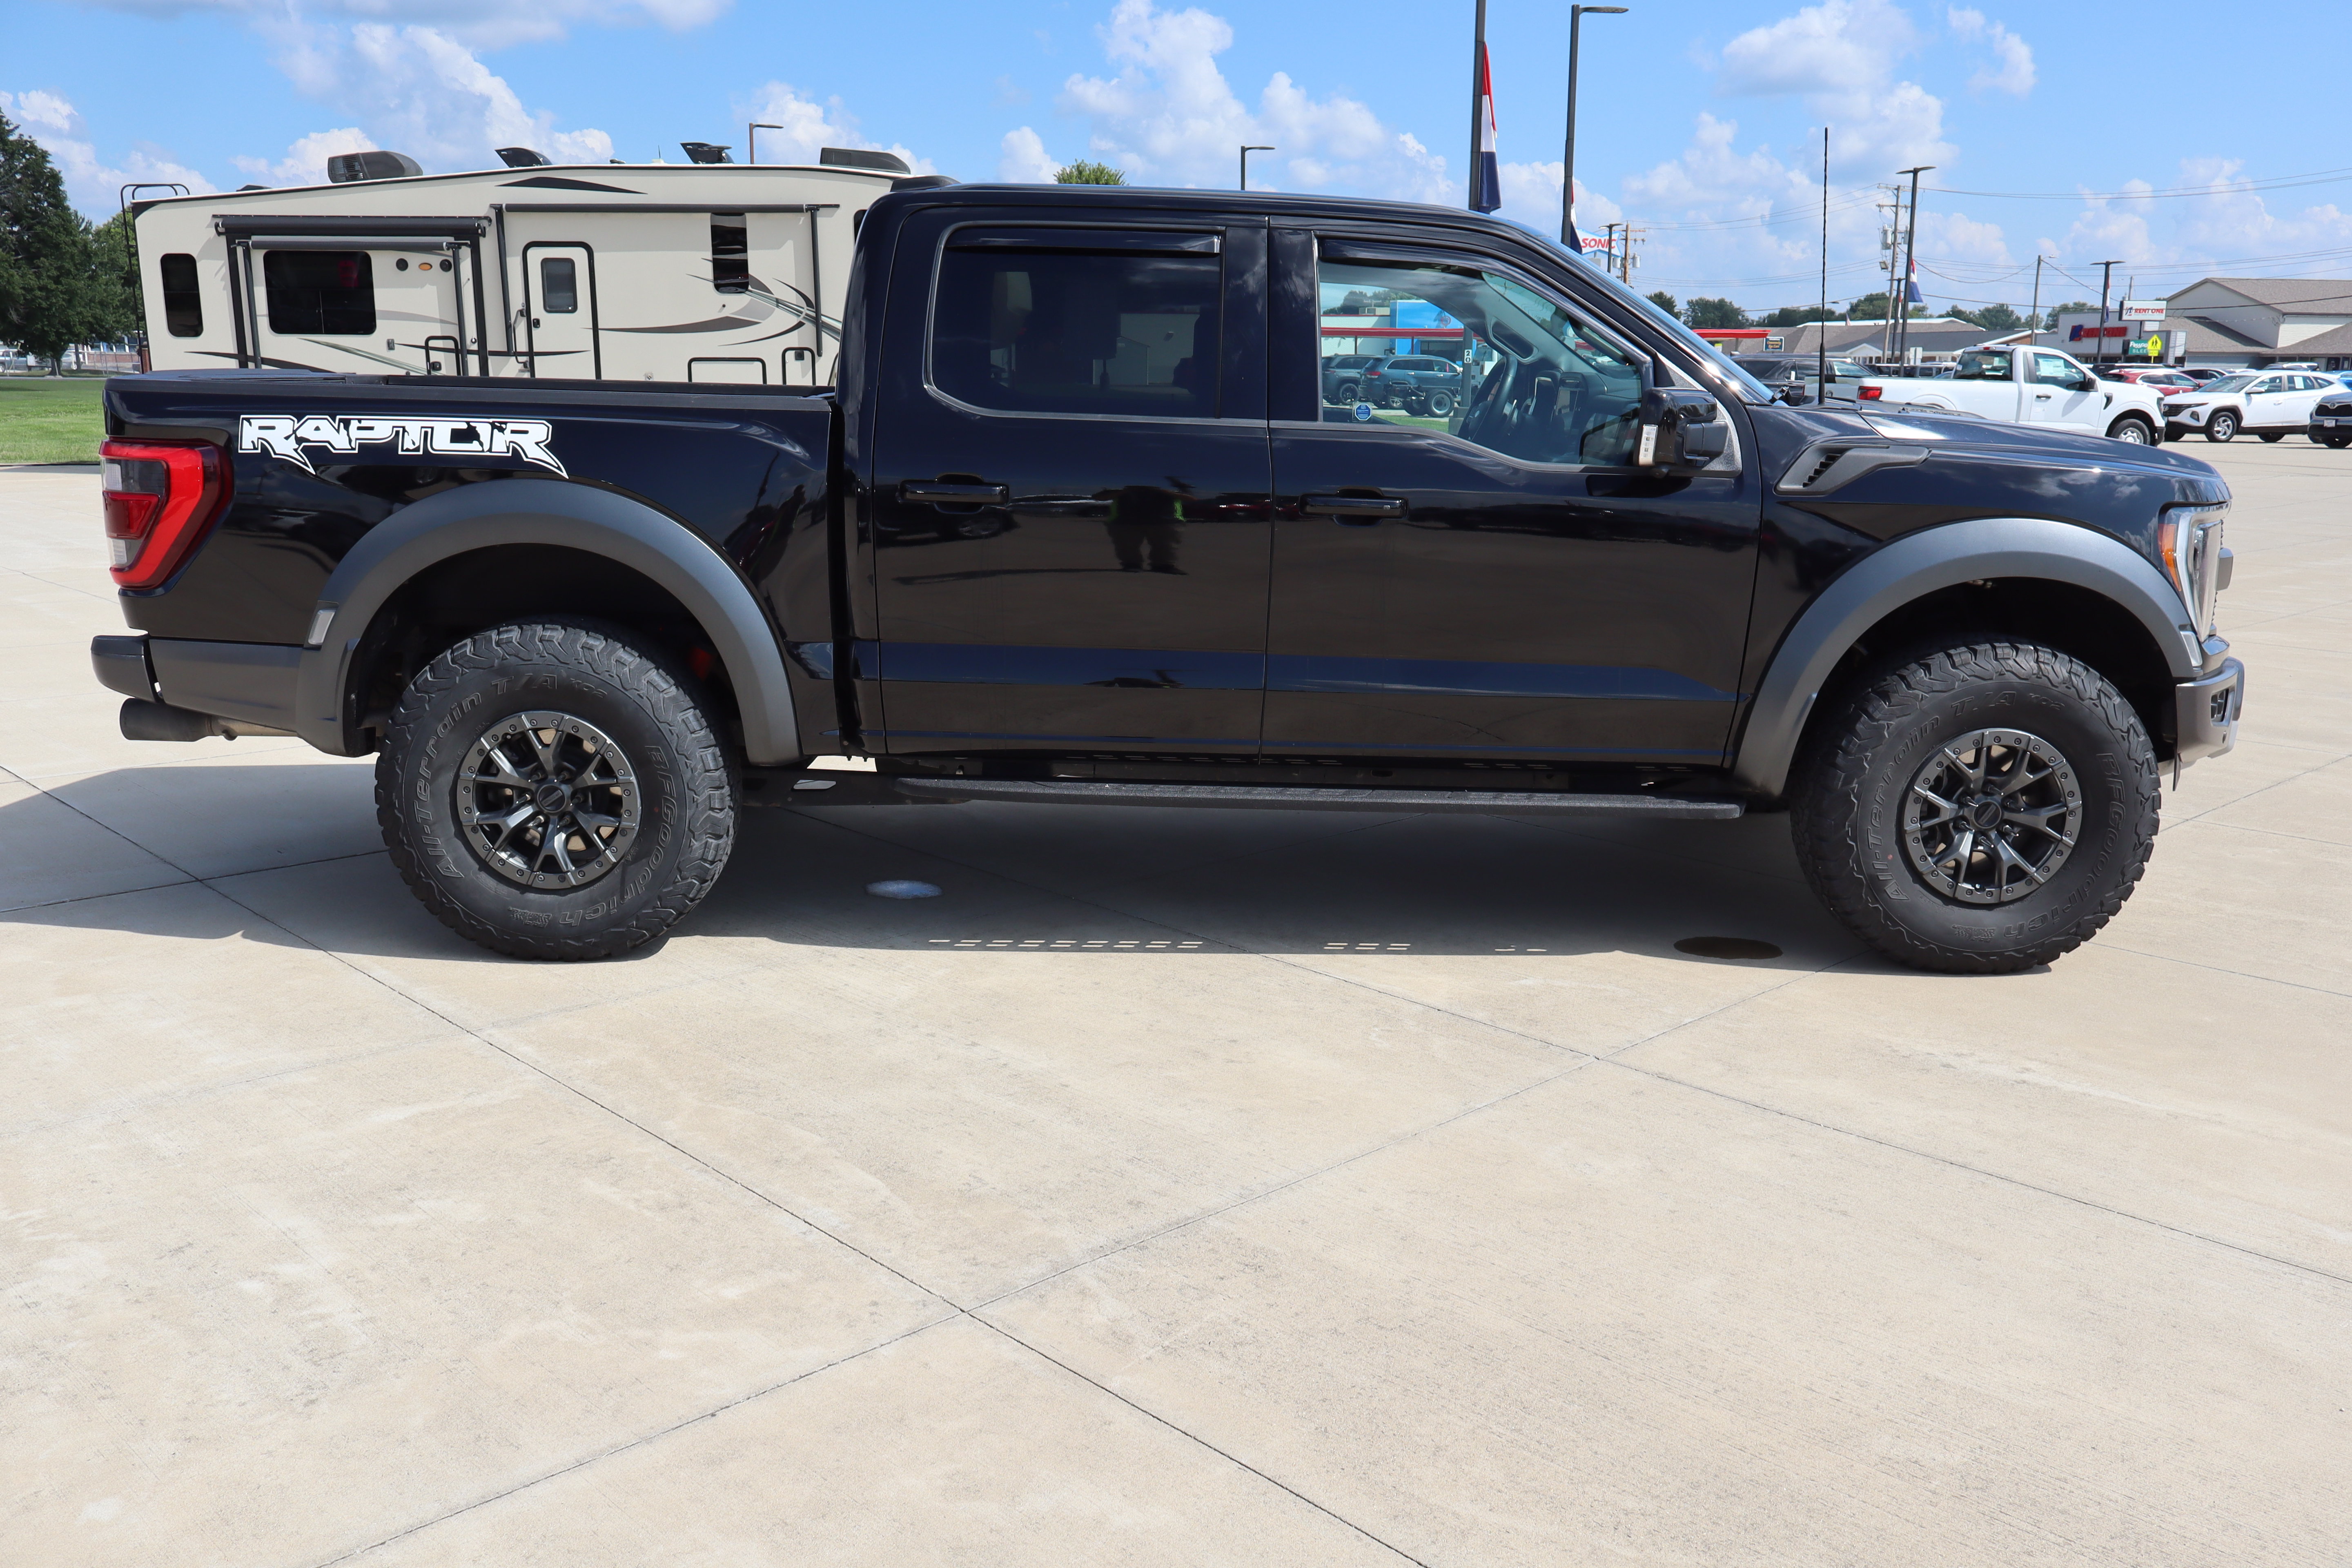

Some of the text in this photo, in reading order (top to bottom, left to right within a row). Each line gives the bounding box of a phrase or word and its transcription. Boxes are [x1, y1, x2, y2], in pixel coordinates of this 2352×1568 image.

[1581, 238, 1617, 249] SONIC
[238, 414, 569, 479] RAPTOR
[414, 693, 482, 878] All-Terrain
[491, 674, 557, 695] T/A
[558, 746, 677, 926] BFGoodrich
[1867, 716, 1940, 900] All-Terrain
[1951, 691, 2016, 716] T/A
[2003, 753, 2125, 938] BFGoodrich
